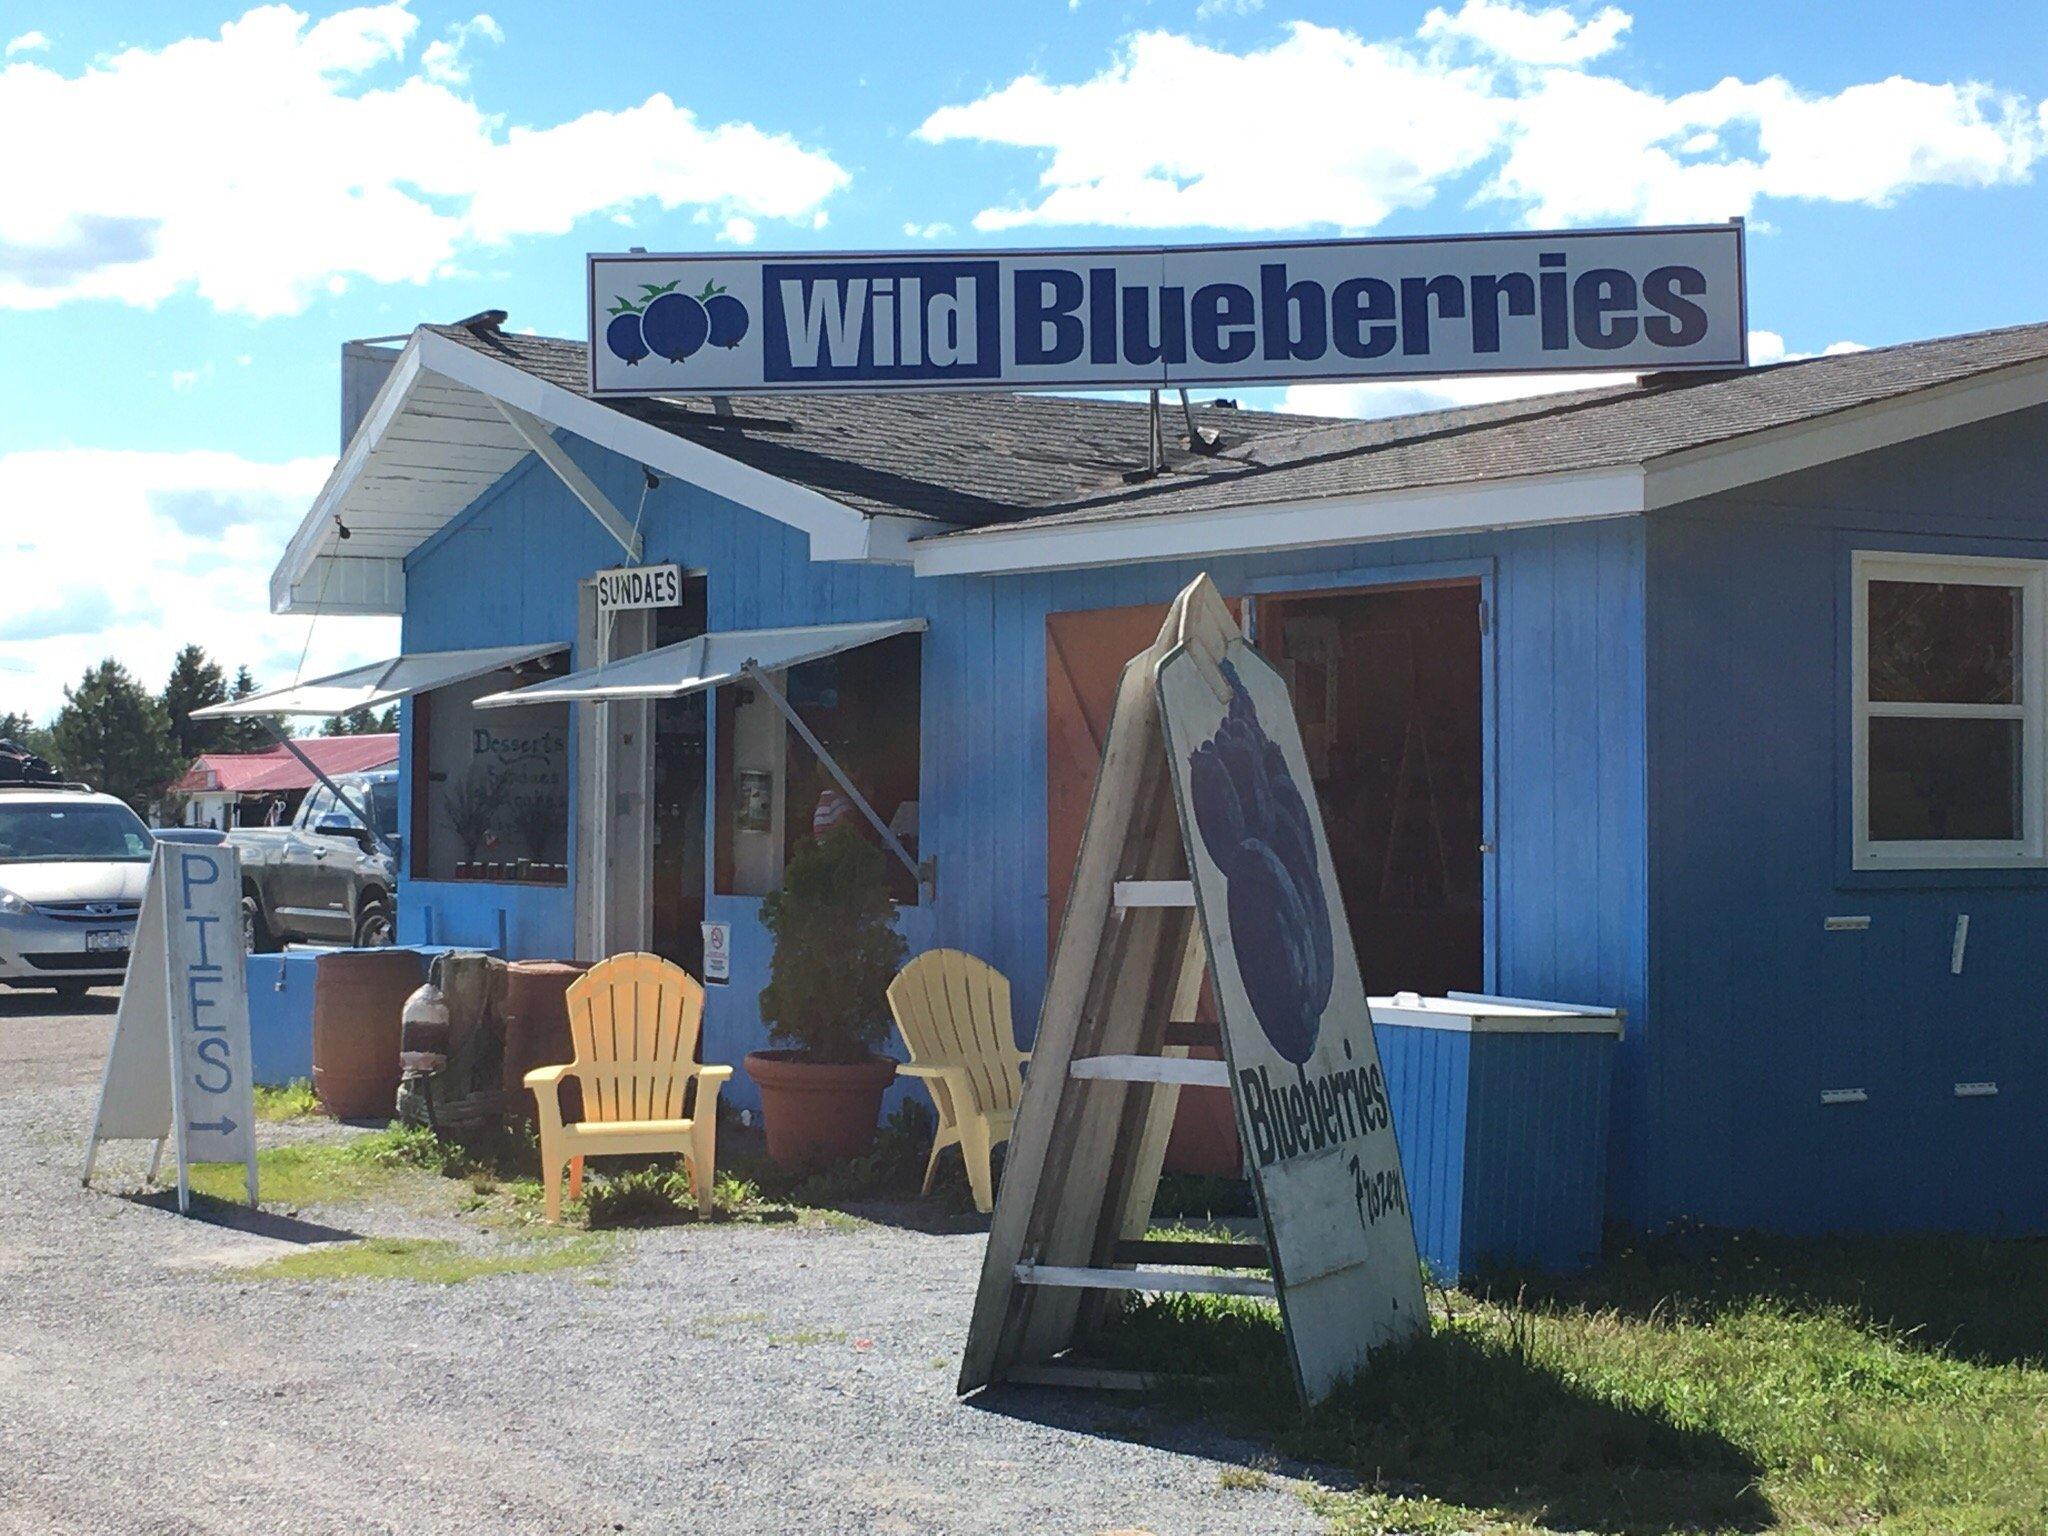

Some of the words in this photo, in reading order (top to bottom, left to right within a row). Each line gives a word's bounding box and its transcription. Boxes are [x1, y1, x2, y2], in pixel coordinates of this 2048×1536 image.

[778, 276, 979, 369] Wild
[1014, 253, 1710, 365] Blueberries
[599, 570, 677, 606] SUNDAES
[473, 728, 565, 754] Desserts
[181, 853, 232, 1095] PIES
[1240, 1038, 1388, 1165] Blueberries
